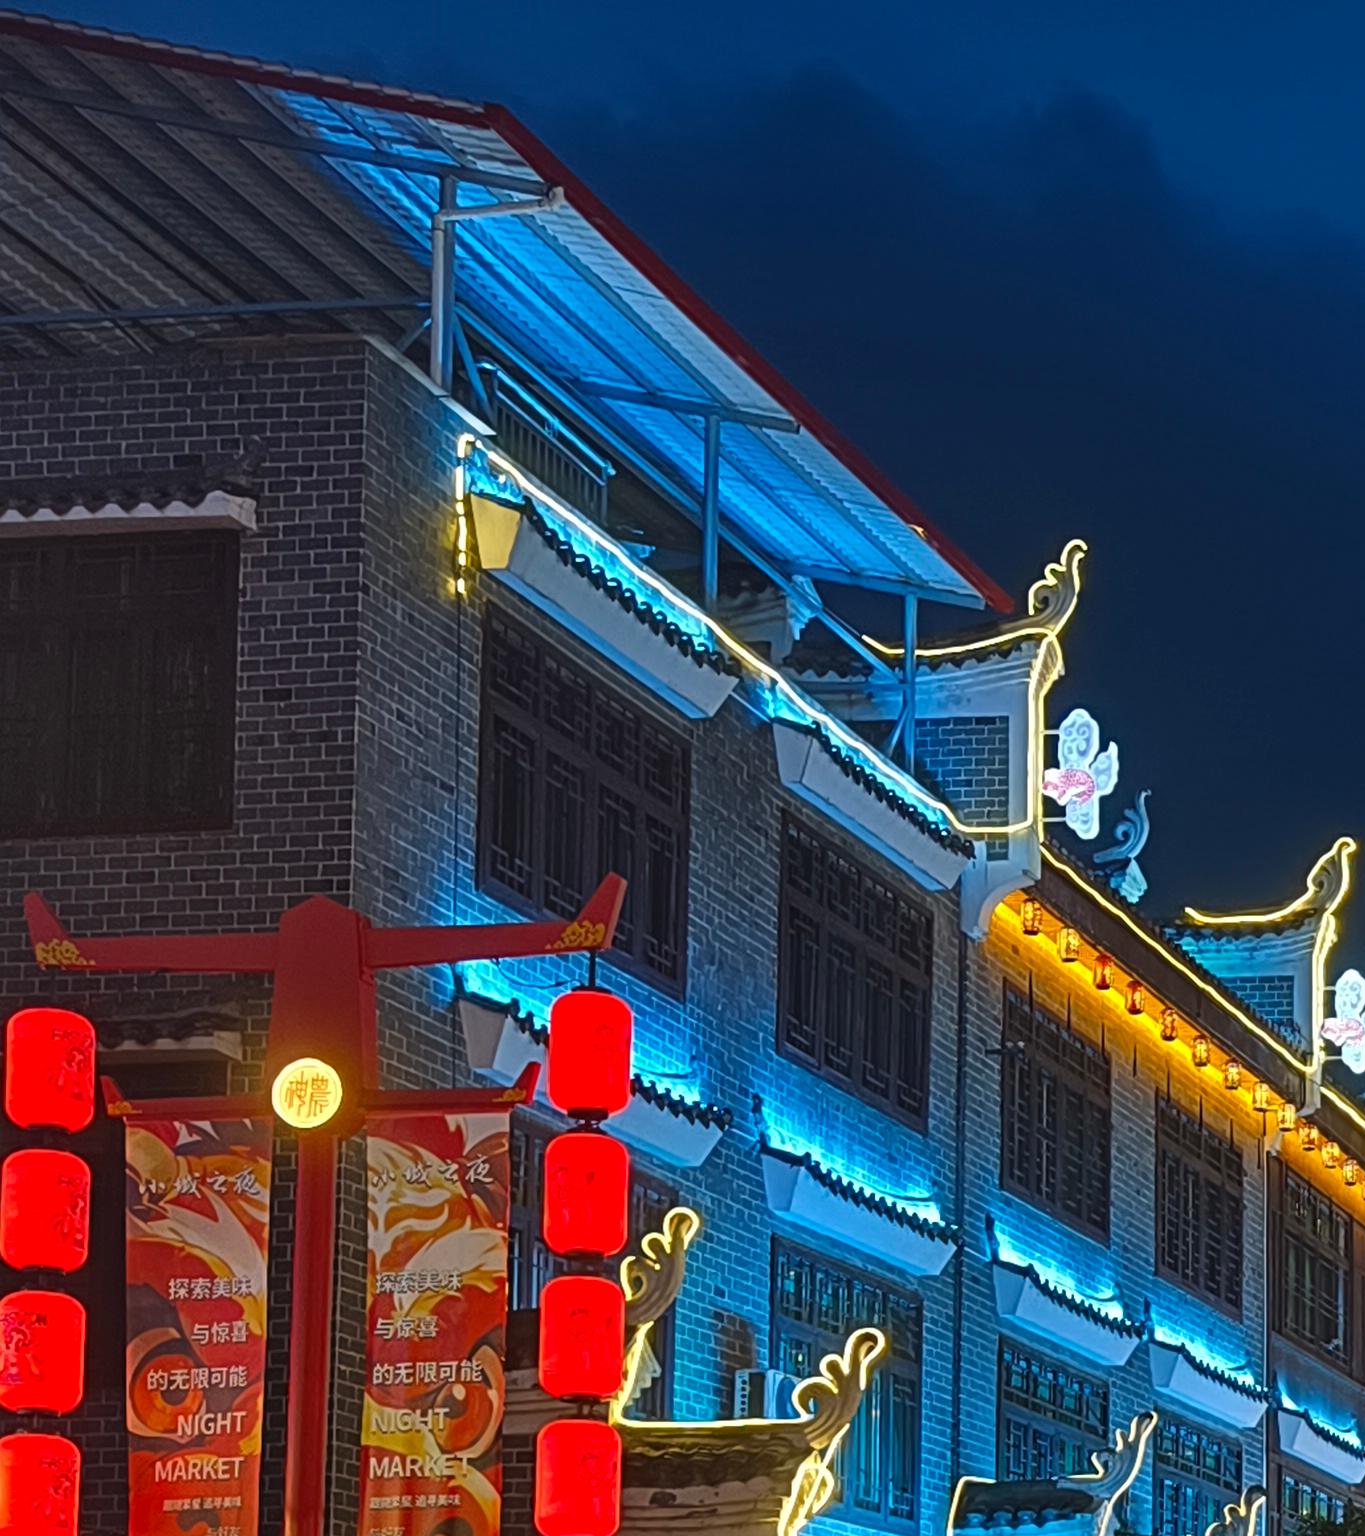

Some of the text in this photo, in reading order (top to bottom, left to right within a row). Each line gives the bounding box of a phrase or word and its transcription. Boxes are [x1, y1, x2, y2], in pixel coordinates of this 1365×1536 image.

[168, 1277, 253, 1300] 探索美味
[375, 1269, 464, 1294] 探索美味
[191, 1321, 249, 1345] 与惊喜
[374, 1316, 439, 1339] 与惊喜
[147, 1366, 248, 1391] 的无限可能
[372, 1360, 483, 1385] 的无限可能
[177, 1411, 247, 1436] NIGHT
[370, 1407, 450, 1433] NIGHT
[155, 1456, 244, 1482] MARKET
[369, 1454, 475, 1480] MARKET
